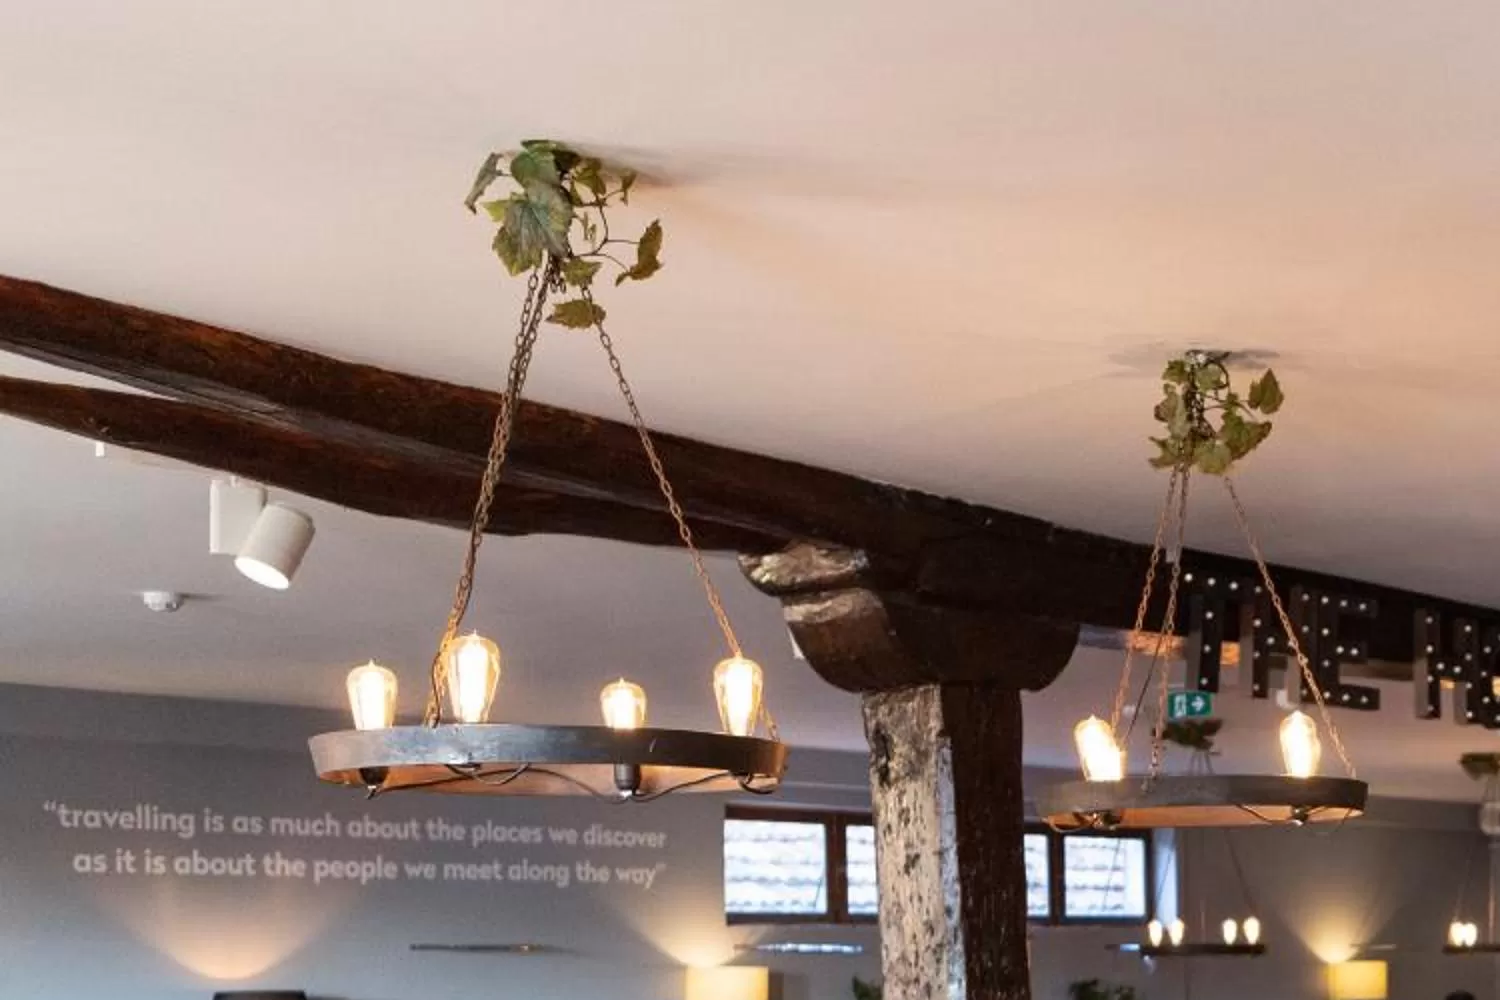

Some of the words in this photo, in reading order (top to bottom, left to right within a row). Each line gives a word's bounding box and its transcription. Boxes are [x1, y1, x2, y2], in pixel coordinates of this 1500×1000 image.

[1177, 568, 1380, 711] THE
[203, 807, 224, 833] is
[232, 814, 264, 835] as
[271, 812, 341, 838] much
[347, 814, 421, 841] about
[425, 816, 466, 841] the
[472, 820, 543, 848] places
[548, 827, 577, 843] we
[583, 824, 667, 848] discover
[73, 853, 107, 873] as
[115, 848, 136, 874] it
[144, 849, 166, 875] is
[173, 850, 257, 876] about
[263, 851, 307, 878] the
[313, 855, 398, 885] people
[404, 862, 436, 879] we
[443, 860, 502, 882] meet
[508, 859, 570, 887] along
[576, 860, 611, 883] the
